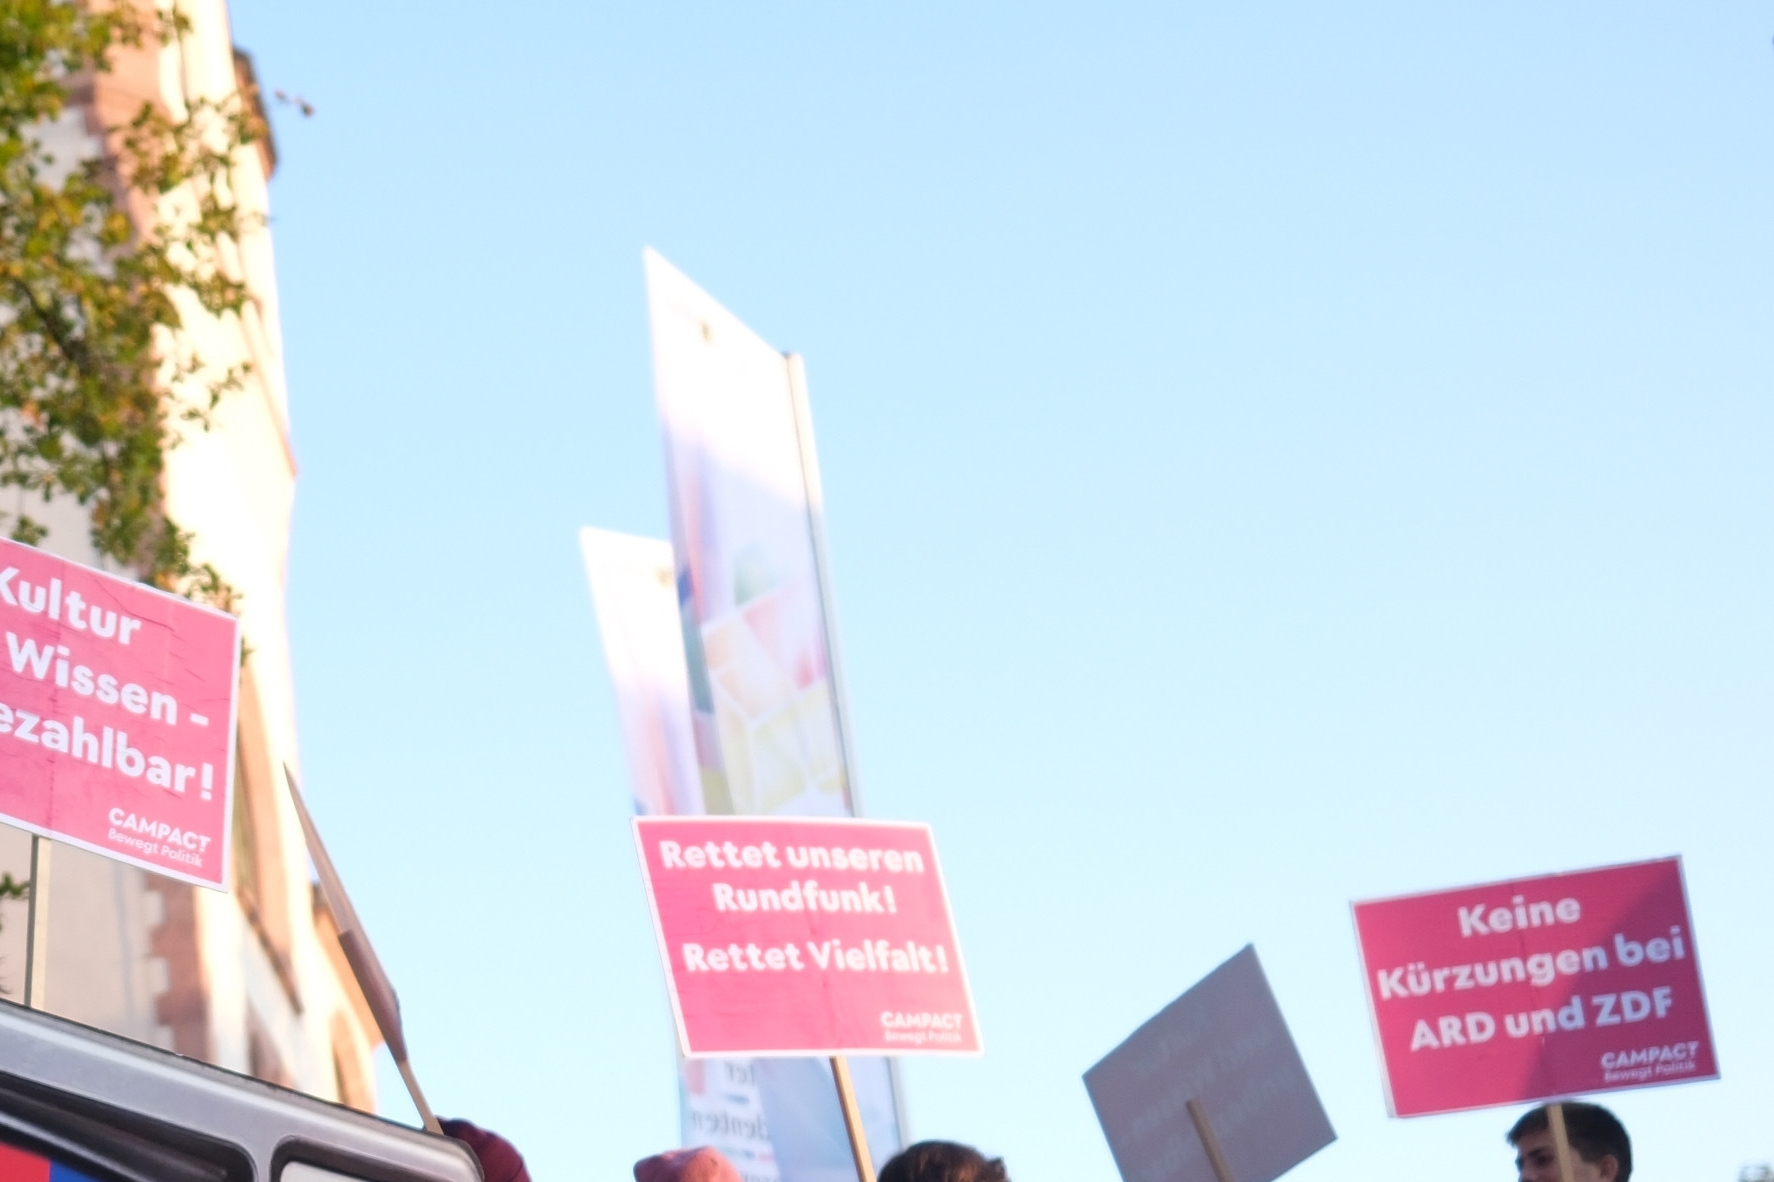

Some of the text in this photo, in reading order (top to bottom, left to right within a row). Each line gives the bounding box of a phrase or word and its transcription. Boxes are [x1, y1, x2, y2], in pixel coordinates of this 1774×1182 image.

[6, 631, 178, 725] Wissen
[108, 828, 203, 867] Bewegt Politik
[109, 807, 211, 852] CAMPACT
[659, 841, 925, 873] Rettet unseren
[712, 879, 897, 914] Rundfunk!
[1457, 895, 1581, 937] Keine
[681, 938, 949, 973] Rettet Vielfalt!
[1377, 925, 1685, 1000] Kürzungen bei
[880, 1010, 963, 1029] CAMPACT
[1411, 986, 1673, 1052] ARD und ZDF
[1601, 1040, 1700, 1070] CAMPACT
